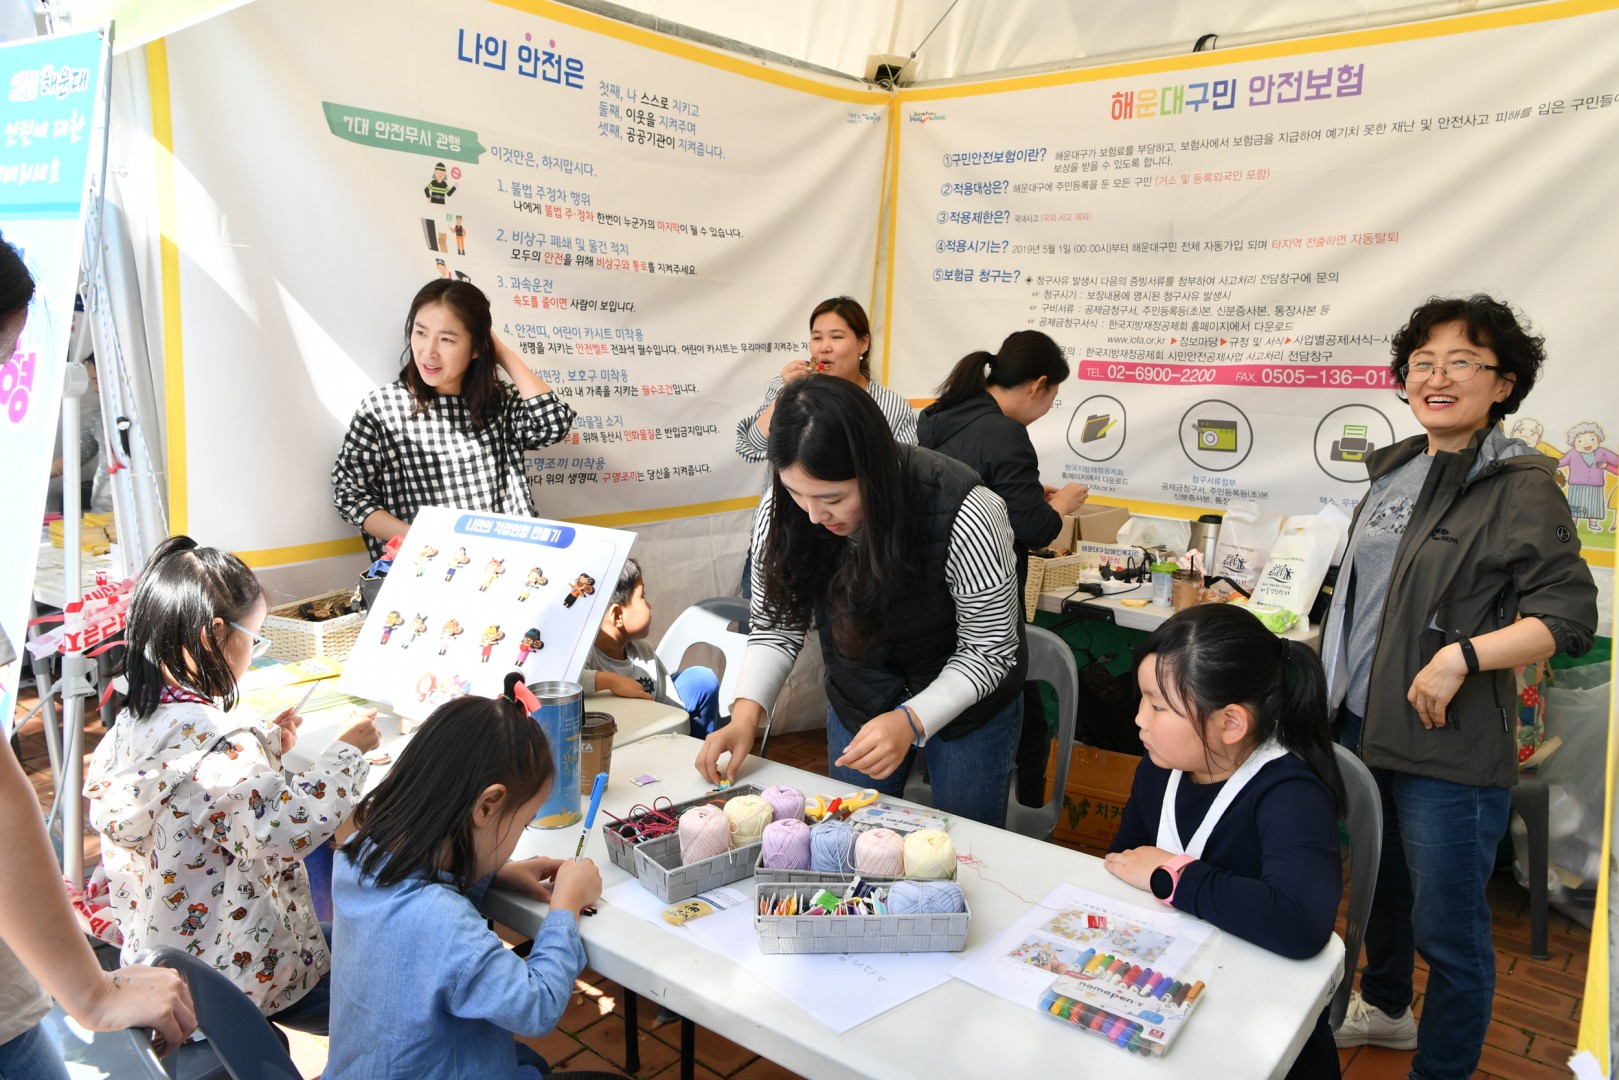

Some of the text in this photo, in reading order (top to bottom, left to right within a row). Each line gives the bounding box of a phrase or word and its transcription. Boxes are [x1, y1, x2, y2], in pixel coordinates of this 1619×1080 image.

[458, 28, 584, 89] 나의 안전은
[599, 80, 700, 117] 첫째, 나 스스로 지키고
[1111, 63, 1365, 120] 해운대구민 안전보험
[598, 101, 696, 136] 둘째, 이웃을 지켜주며
[343, 115, 461, 152] 7대 안전무시 관행
[1055, 148, 1096, 161] 해운대구가
[1099, 145, 1134, 158] 보험료를
[1180, 137, 1229, 151] 보험사에서
[1233, 133, 1274, 147] 보험금을
[1278, 129, 1322, 144] 지급하여
[1326, 125, 1359, 140] 예기치
[1363, 122, 1387, 136] 못한
[1391, 120, 1415, 133] 재난
[1420, 118, 1432, 131] 및
[1438, 113, 1490, 130] 안전사고
[1495, 106, 1532, 123] 피해를
[1538, 100, 1565, 116] 입은
[598, 121, 726, 160] 셋째, 공공기관이 지켜줍니다.
[490, 146, 539, 169] 이것만은,
[1053, 155, 1173, 174] 보상을 받을 있도록 합니다.
[1013, 182, 1053, 194] 해운대구에
[1056, 179, 1097, 192] 주민등록을
[1113, 177, 1131, 189] 모든
[1134, 176, 1152, 188] 구민
[1194, 169, 1242, 185] 등록외국인
[1246, 168, 1271, 181] 포함)
[511, 181, 591, 207] 불법 주정차 행위
[514, 200, 744, 238] 나에게 불법 한번이 누군가의 마지막이 있습니다.
[512, 230, 629, 256] 비상구 폐쇄 및 물건 적치
[1012, 244, 1040, 254] 2019년
[1132, 241, 1177, 253] 해운대구민
[1181, 240, 1200, 252] 전체
[1203, 240, 1244, 252] 자동가입
[1247, 239, 1268, 251] 되며
[1271, 238, 1302, 250] 타지역
[1305, 234, 1347, 248] 전출하면
[1350, 231, 1399, 245] 자동탈퇴
[511, 248, 698, 276] 모두의 안전을 위해 비상구와 통로를 지켜주세요.
[510, 277, 553, 294] 과속운전
[979, 269, 1021, 284] 청구는?
[1036, 271, 1340, 286] 청구사유 발생시 다음의 사고처리 전담창구에 문의
[513, 294, 636, 313] 속도를 줄이면 사람이 보입니다.
[1041, 304, 1074, 314] 구비서류
[1274, 304, 1317, 316] 통장사본
[515, 324, 644, 342] 안전띠, 어린이 카시트 미착용
[1039, 317, 1294, 332] 공제금청구서식 한국지방재정공제회 홈페이지에서 다운로드
[519, 341, 772, 356] 생명을 지키는 안전벨트 전좌석 필수입니다. 어린이 카시트는 우리아이를
[1179, 336, 1218, 347] 정보마당
[1086, 347, 1334, 362] 한국지방재정공제회 시민안전공제사업 사고처리 전담창구
[568, 369, 629, 383] 보호구 미착용
[1107, 364, 1217, 383] 02-6900-2200
[586, 383, 699, 397] 가족을 지키는 필수조건입니다.
[606, 414, 624, 427] 소지
[583, 424, 720, 444] 위해 등산시 인화물질은 반입금지입니다.
[572, 456, 606, 470] 미착용
[545, 463, 712, 484] 위의 구명조끼는 당신을 지켜줍니다.
[1192, 475, 1236, 487] 청구서류첨부
[465, 518, 494, 534] 나만의
[1078, 980, 1138, 1005] namepen
